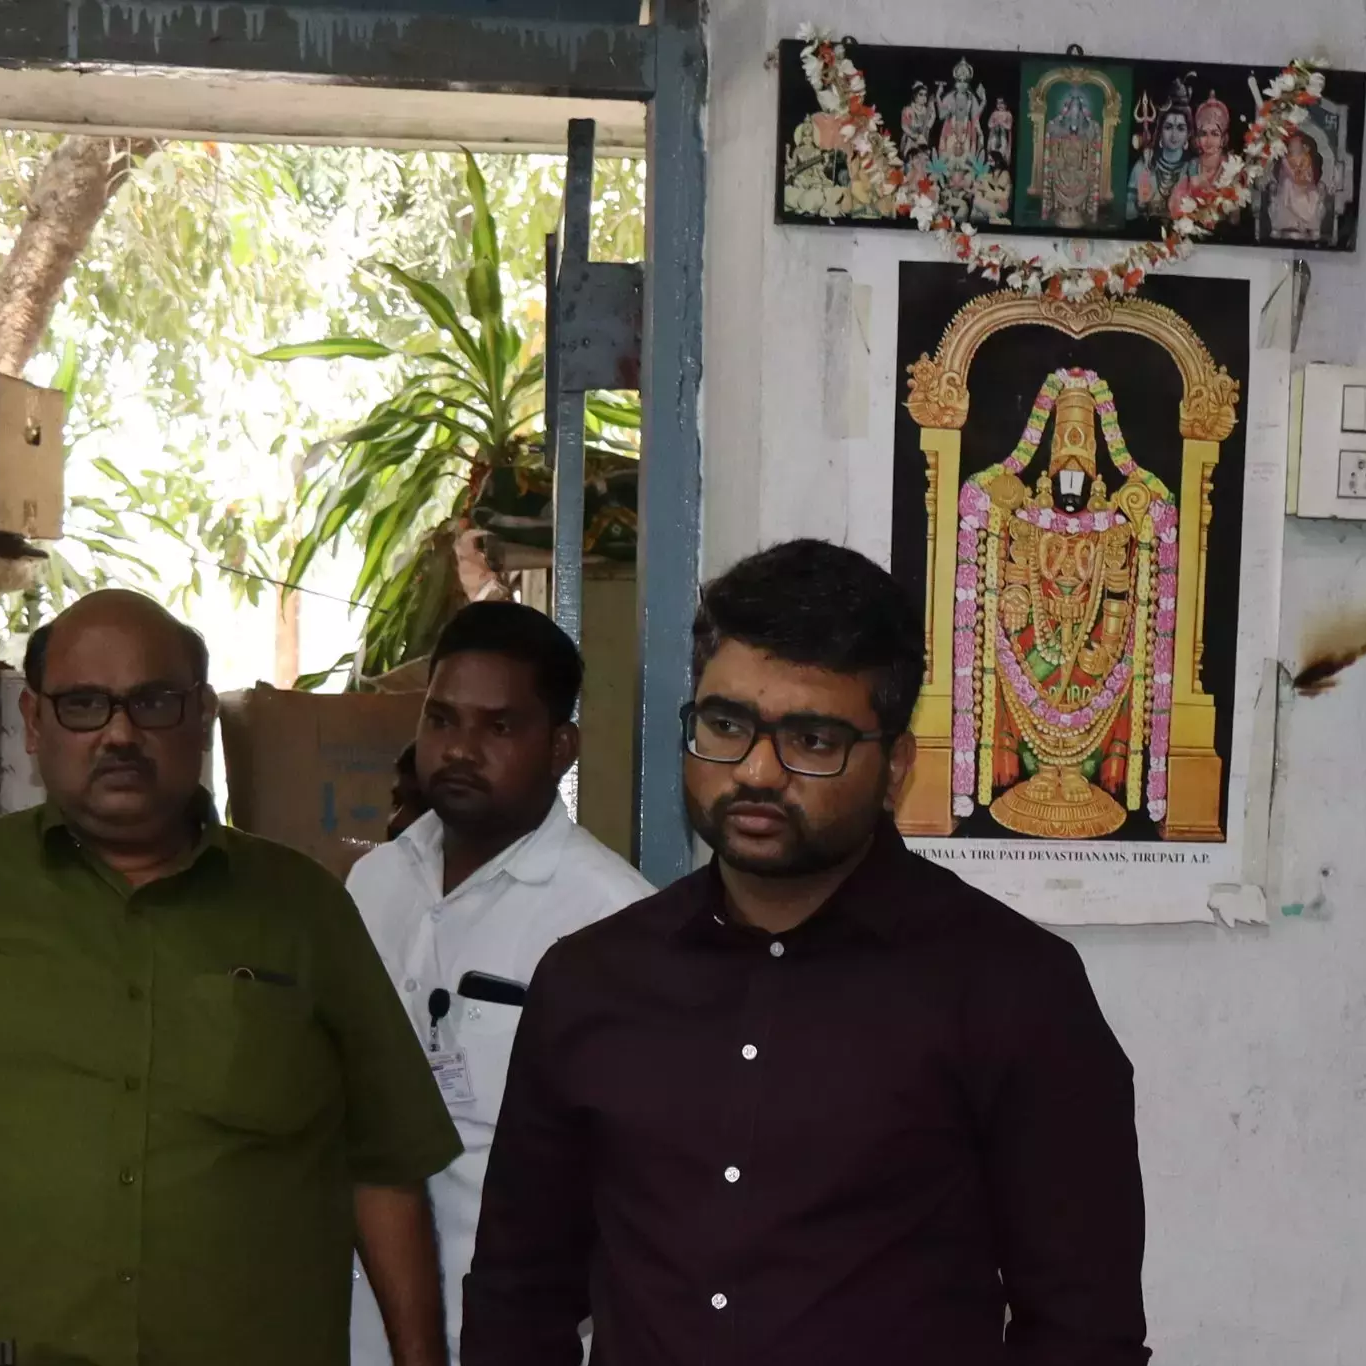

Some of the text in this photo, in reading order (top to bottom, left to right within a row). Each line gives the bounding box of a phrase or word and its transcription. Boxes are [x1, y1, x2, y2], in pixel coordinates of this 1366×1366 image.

[971, 849, 1211, 864] TIRUPATI DEVASTHANAMS, TIRUPATI A.P.
